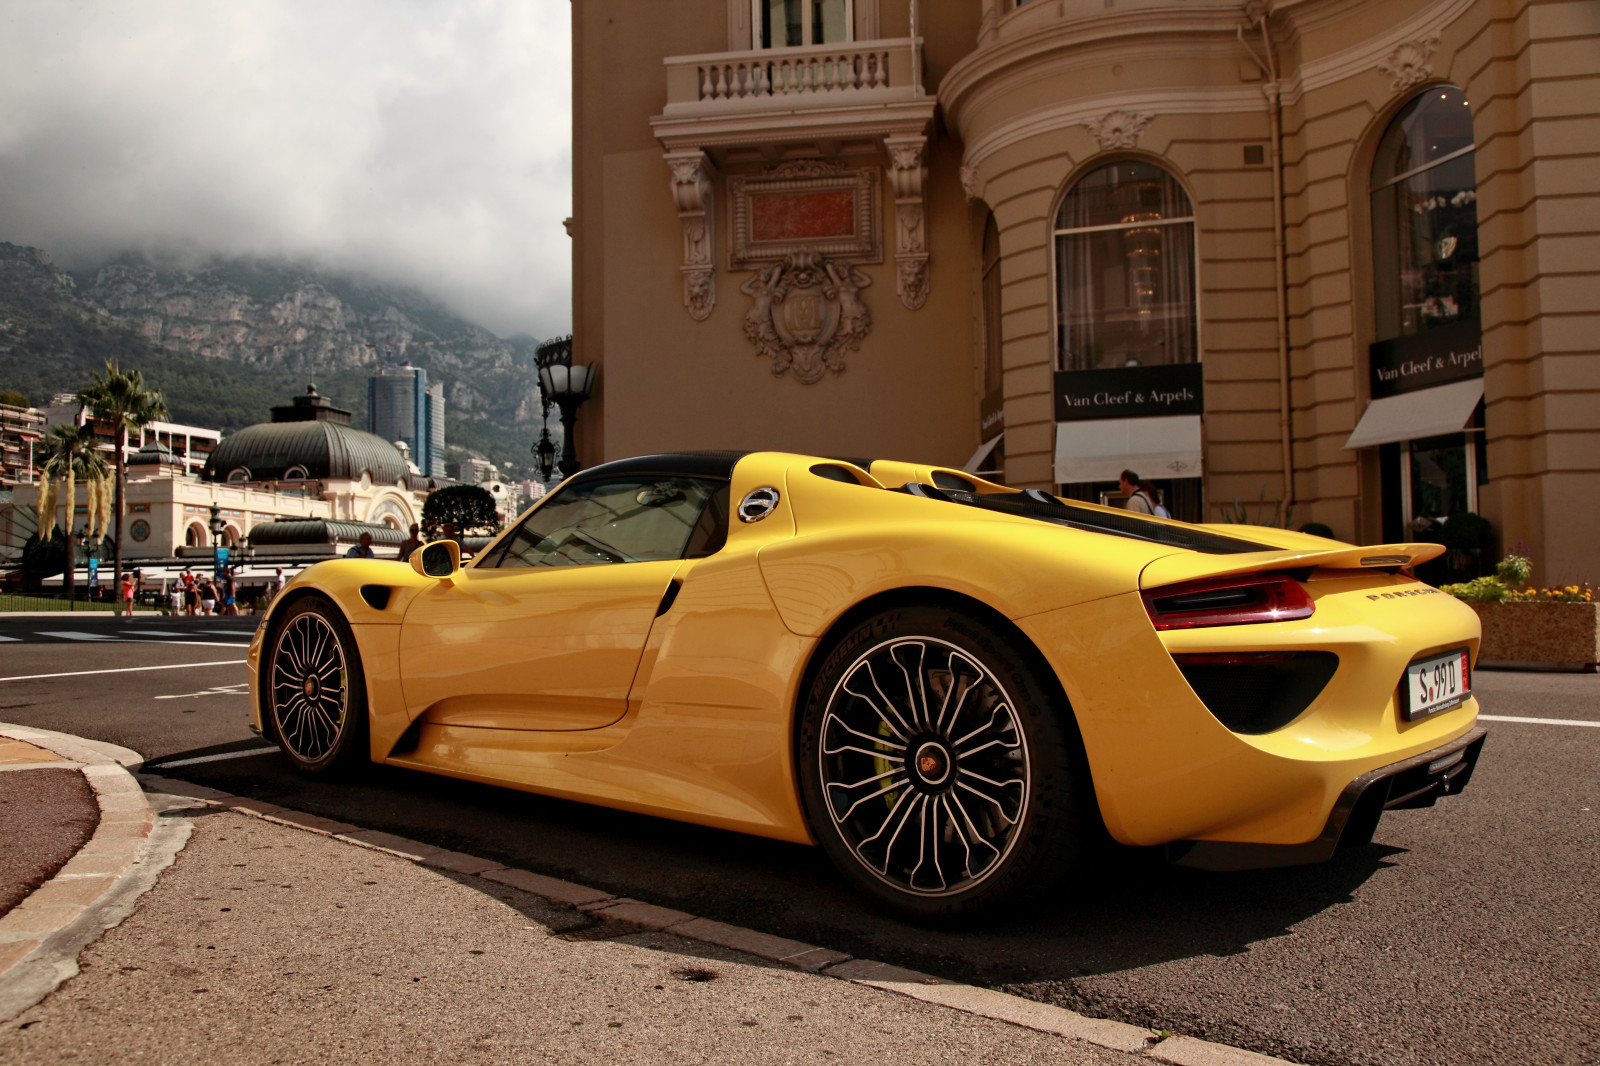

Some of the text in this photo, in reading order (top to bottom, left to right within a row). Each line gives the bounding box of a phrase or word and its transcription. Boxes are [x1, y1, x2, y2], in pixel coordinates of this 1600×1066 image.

[1377, 344, 1482, 381] Van Cleef & Arpel
[1064, 387, 1194, 406] Van Cleef & Arpels
[813, 623, 874, 700] MICHELIN
[1419, 668, 1428, 703] S
